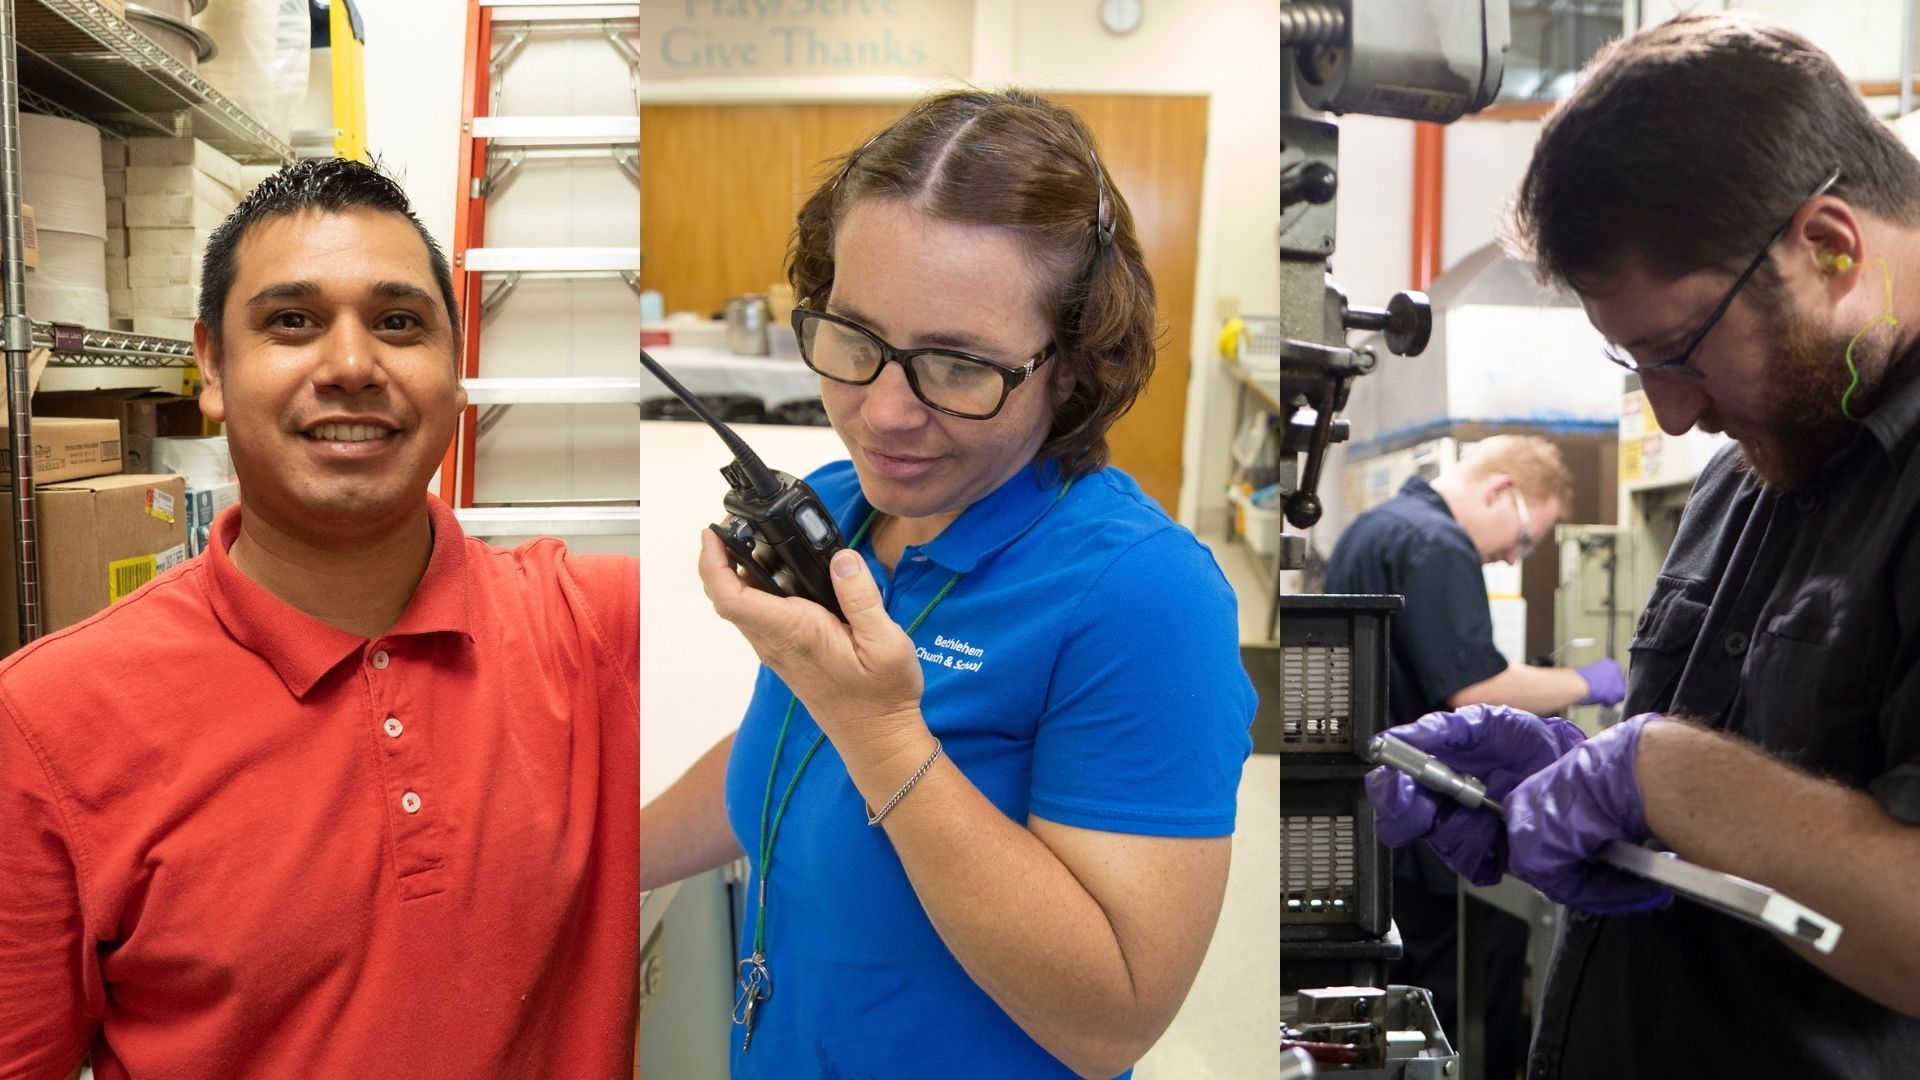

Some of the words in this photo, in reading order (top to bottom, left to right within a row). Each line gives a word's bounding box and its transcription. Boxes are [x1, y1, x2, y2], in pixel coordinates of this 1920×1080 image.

[659, 26, 759, 70] Give
[915, 646, 944, 664] Church
[943, 656, 954, 668] &
[934, 634, 984, 658] Bethlehem
